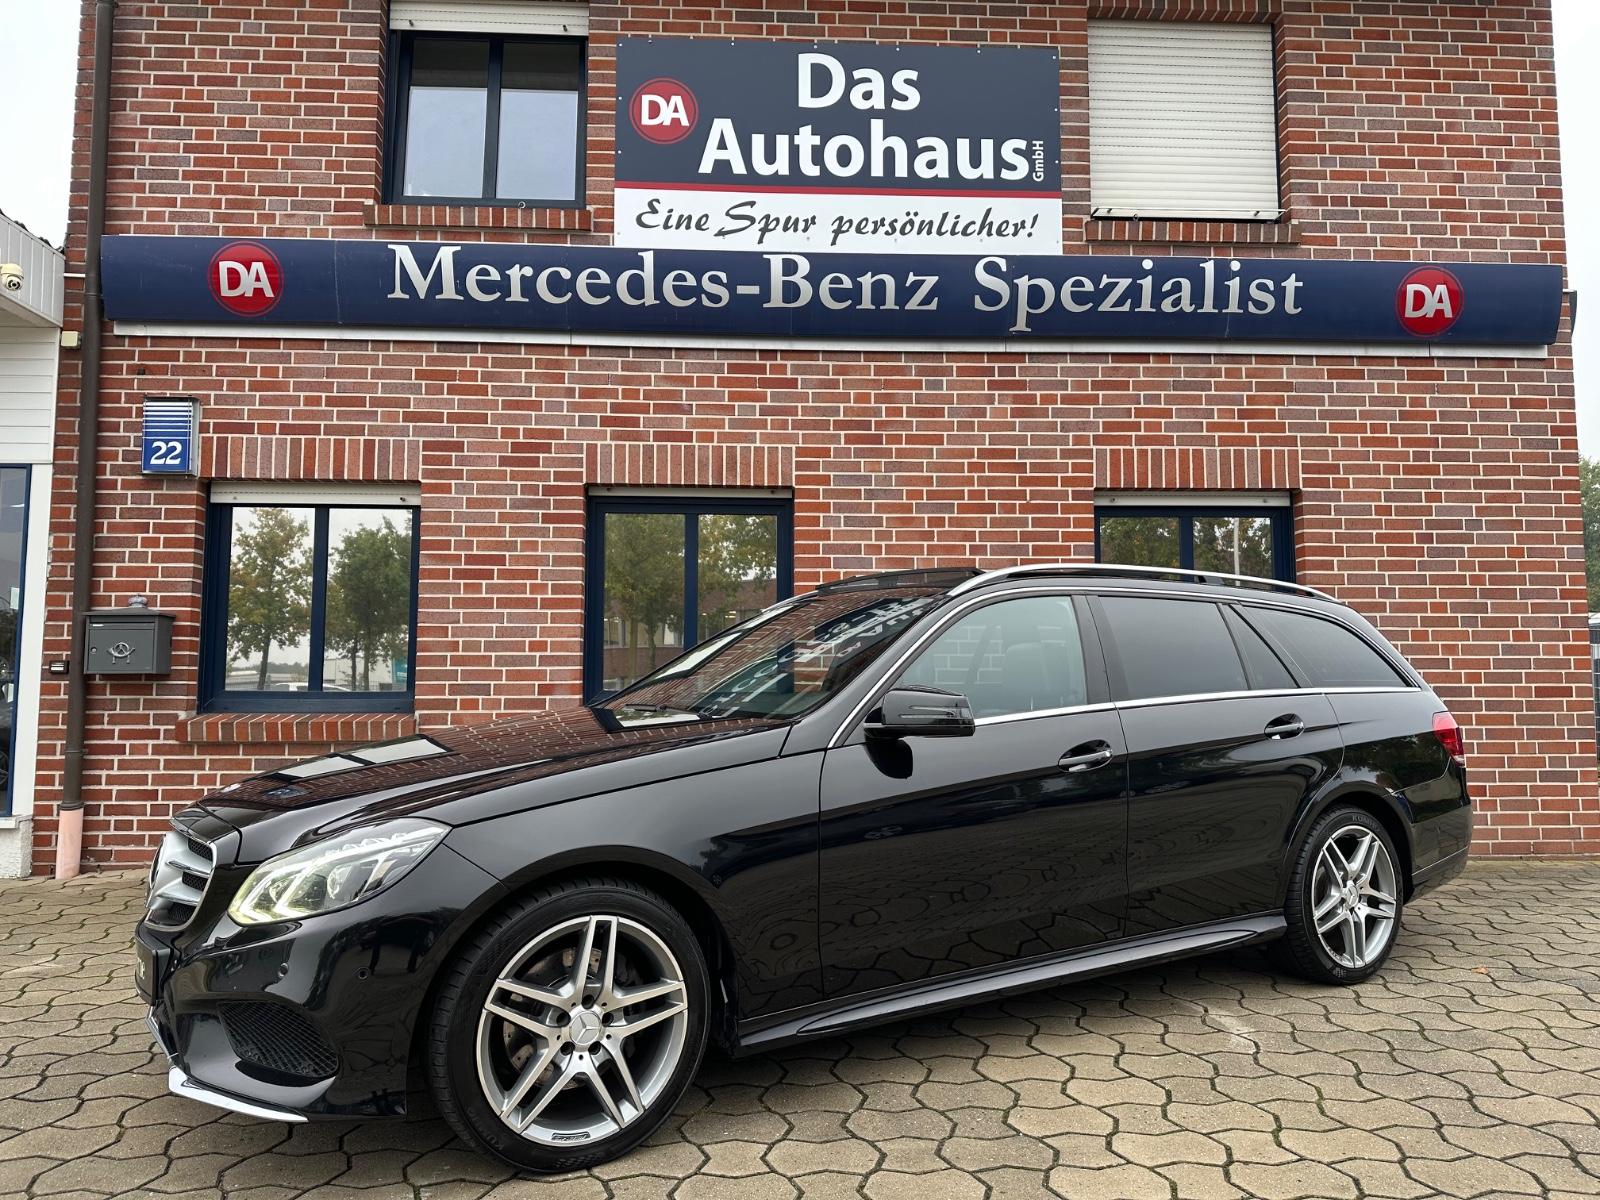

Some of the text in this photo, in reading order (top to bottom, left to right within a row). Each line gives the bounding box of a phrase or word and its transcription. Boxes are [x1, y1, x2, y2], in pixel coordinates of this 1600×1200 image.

[797, 52, 921, 111] Das
[640, 94, 690, 127] DA
[698, 117, 1030, 181] Autohaus
[1032, 139, 1045, 182] GmbH
[635, 198, 1039, 247] Eine Spur persönlicher!
[218, 260, 275, 298] DA
[387, 243, 1304, 333] Mercedes-Benz Spezialist
[1403, 282, 1453, 319] DA
[149, 439, 183, 465] 22
